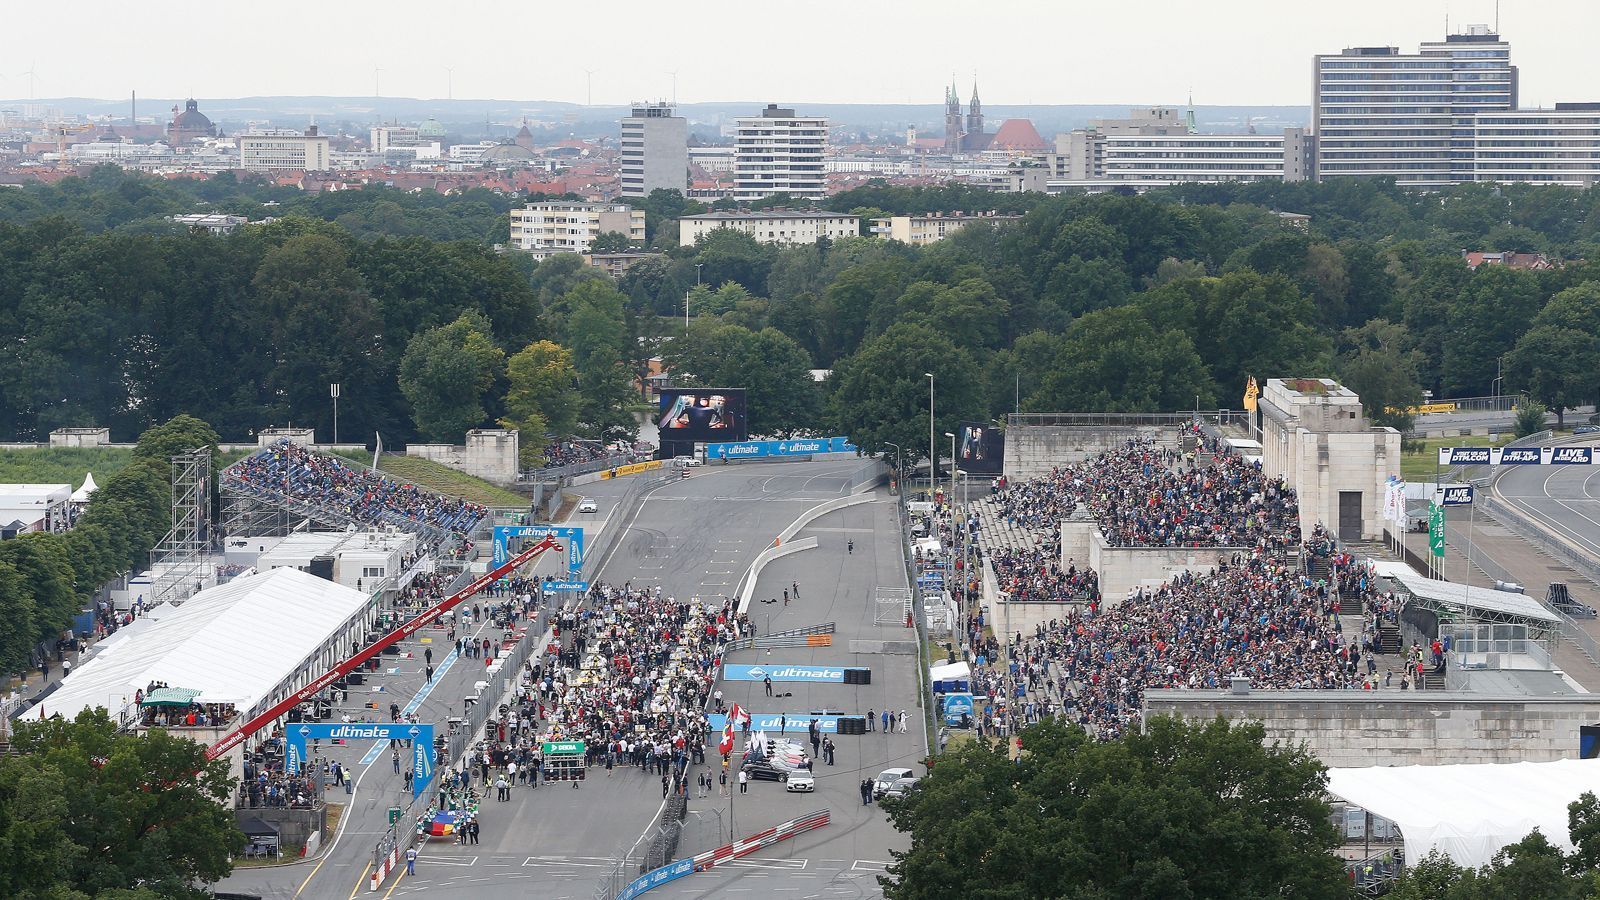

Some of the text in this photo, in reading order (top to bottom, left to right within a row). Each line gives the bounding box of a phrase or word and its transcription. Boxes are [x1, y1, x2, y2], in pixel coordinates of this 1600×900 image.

[728, 445, 759, 455] ultimate
[789, 442, 820, 452] ultimate
[1559, 449, 1584, 457] LIVE
[1448, 489, 1469, 497] LIVE
[518, 528, 559, 536] ultimate
[772, 668, 842, 679] ultimate
[330, 726, 390, 737] ultimate
[415, 743, 423, 779] ultimate
[675, 862, 691, 874] ultimate
